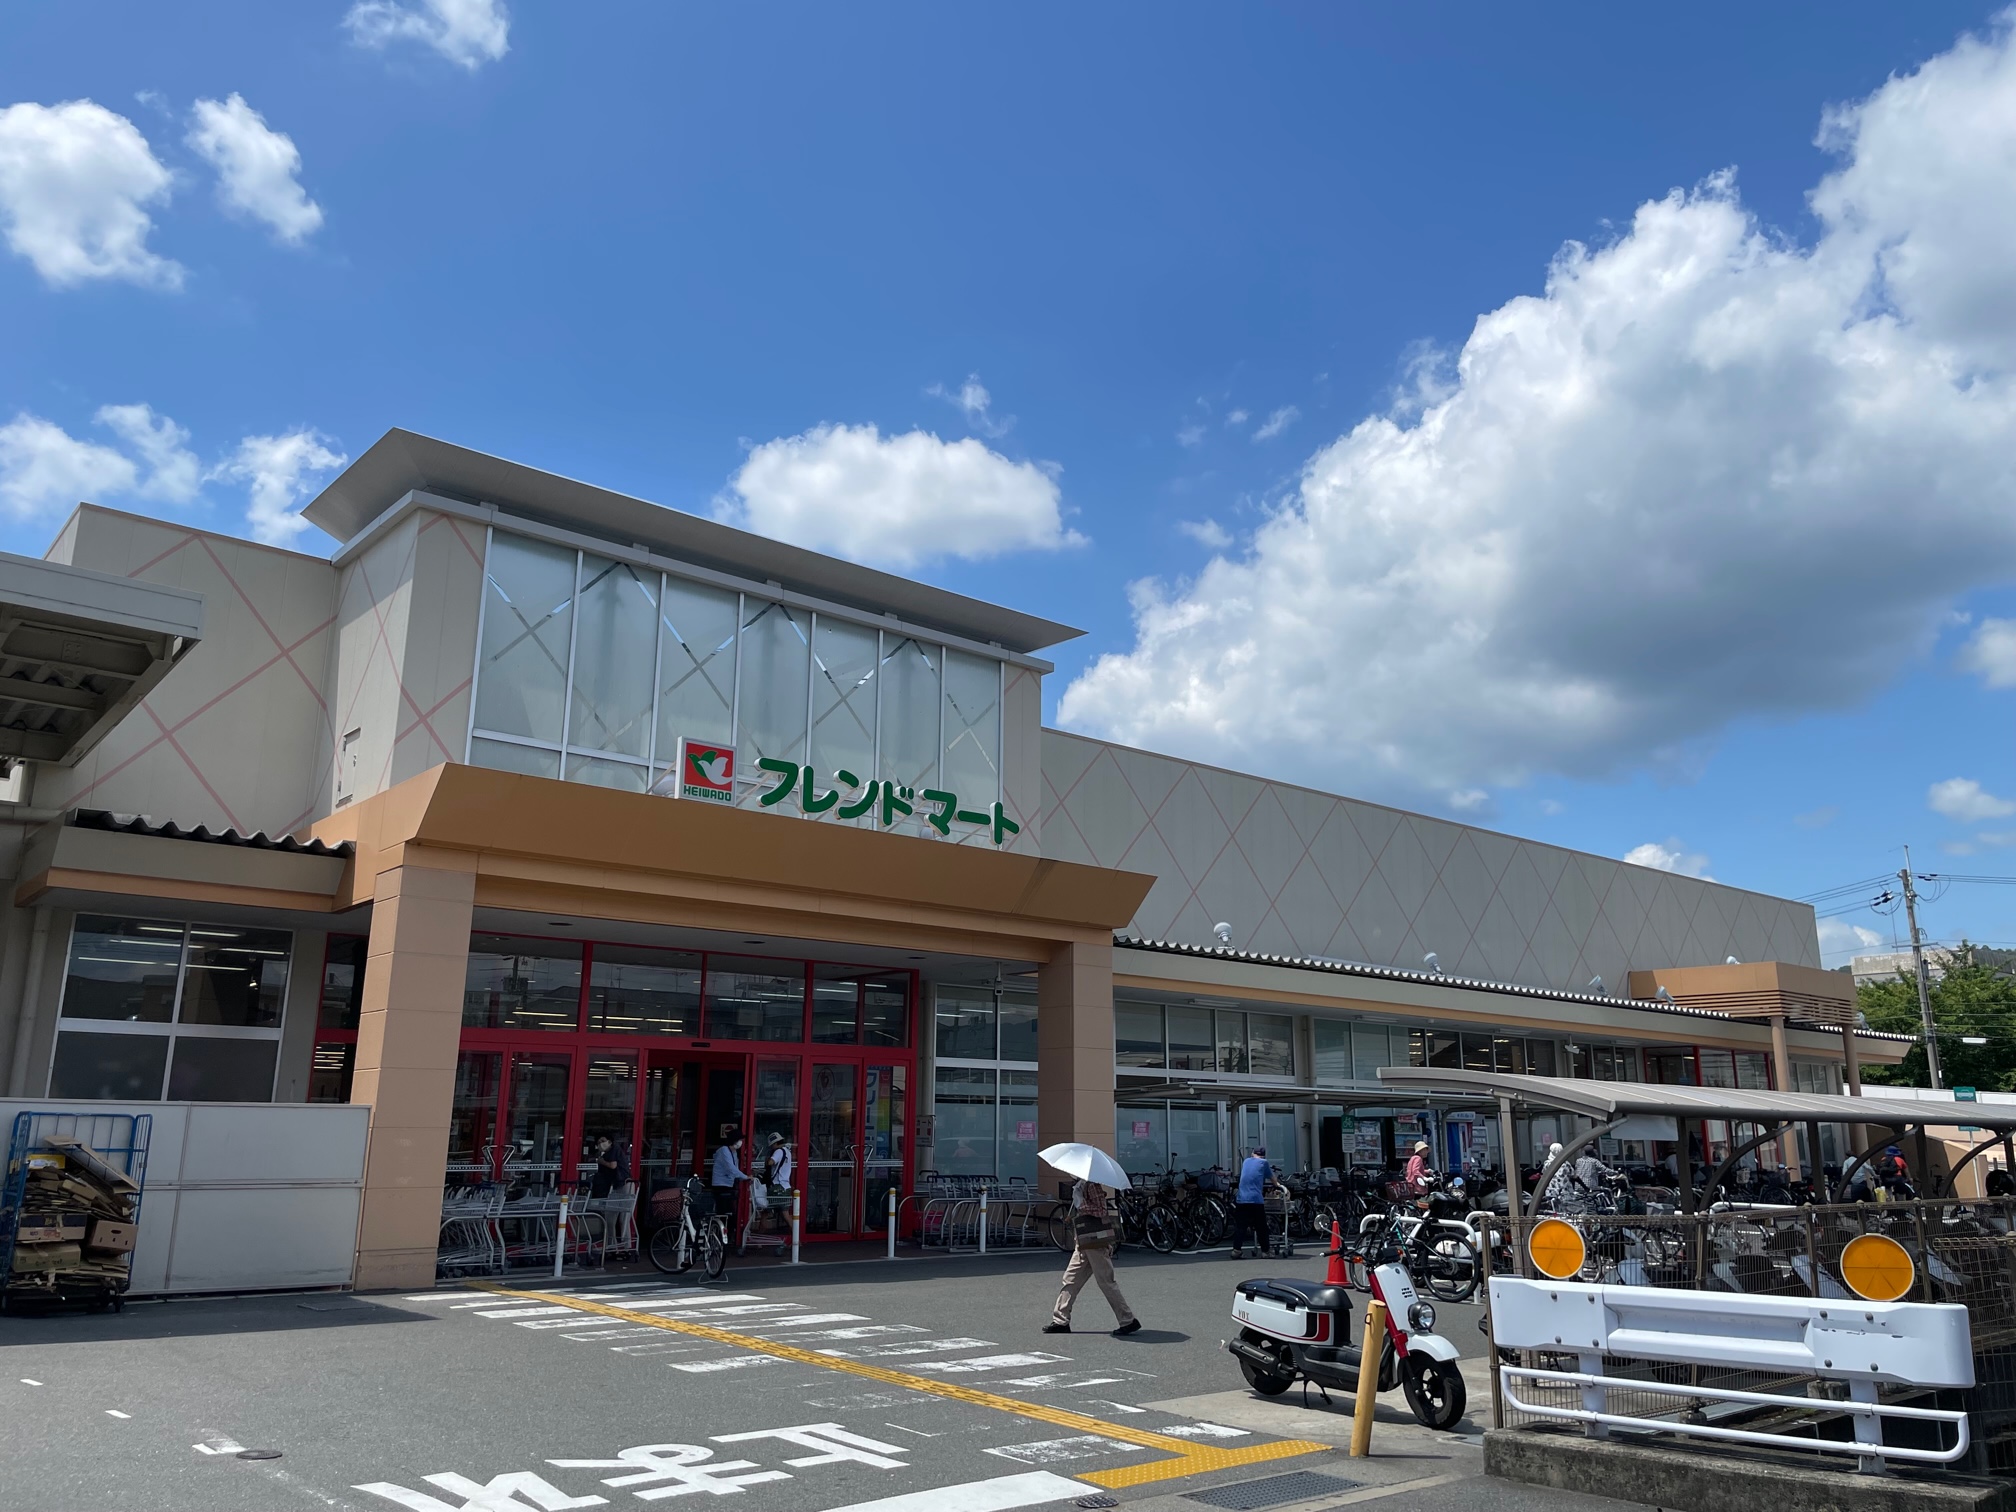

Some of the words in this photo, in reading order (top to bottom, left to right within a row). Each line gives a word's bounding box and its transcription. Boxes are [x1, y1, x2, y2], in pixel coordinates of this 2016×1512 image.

[683, 785, 732, 802] HEIWADO
[754, 757, 1020, 846] フレンドマート
